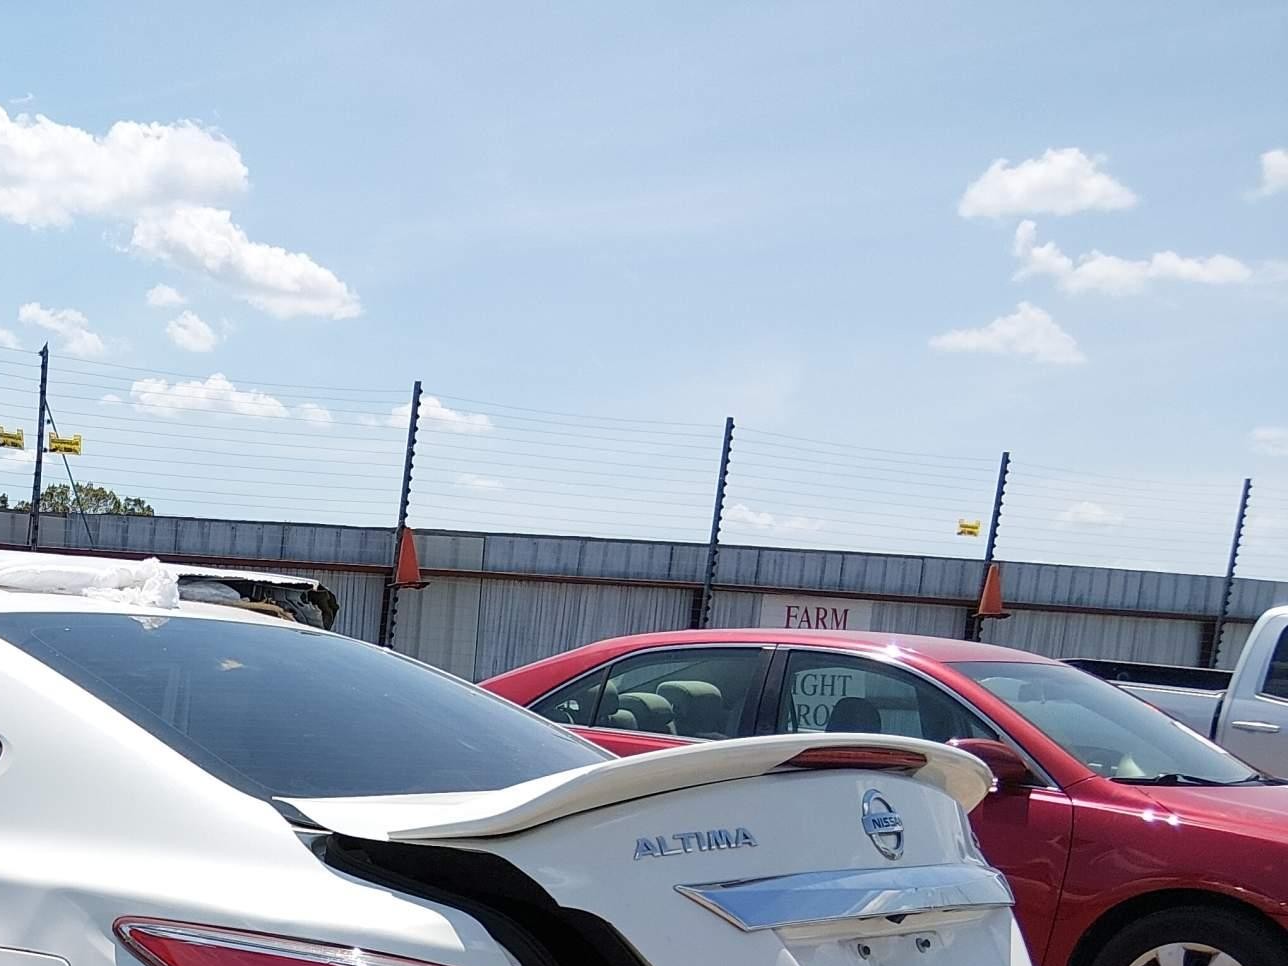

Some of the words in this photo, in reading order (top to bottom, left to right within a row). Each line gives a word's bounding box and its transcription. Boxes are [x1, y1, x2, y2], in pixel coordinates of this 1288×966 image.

[784, 605, 850, 630] FARM
[793, 673, 852, 697] IGHT
[633, 827, 759, 861] ALTIMA
